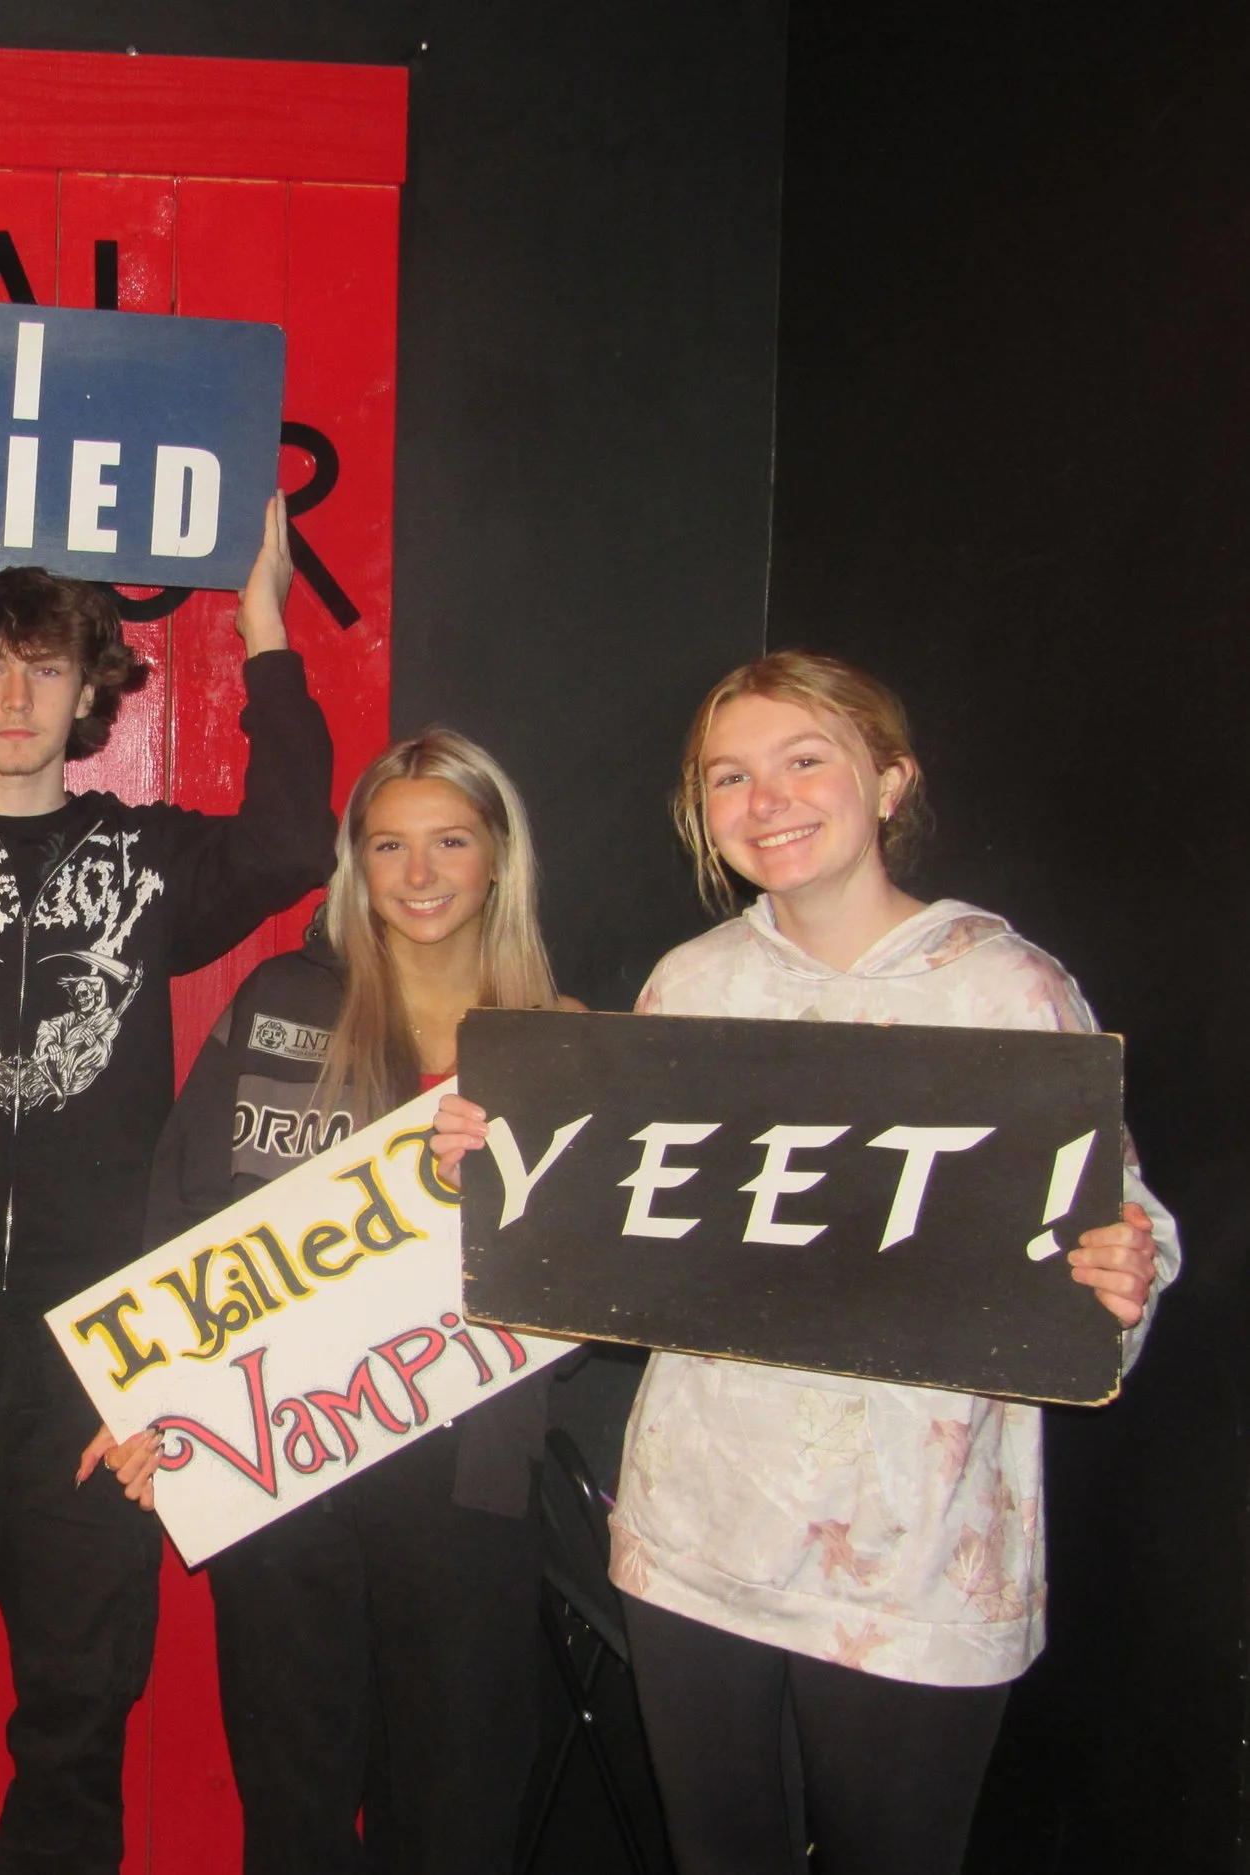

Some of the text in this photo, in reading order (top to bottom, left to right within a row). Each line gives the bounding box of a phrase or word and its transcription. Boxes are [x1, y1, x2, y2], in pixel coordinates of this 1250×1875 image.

[12, 322, 45, 420] I
[72, 1289, 168, 1391] I
[151, 1157, 428, 1361] Killed
